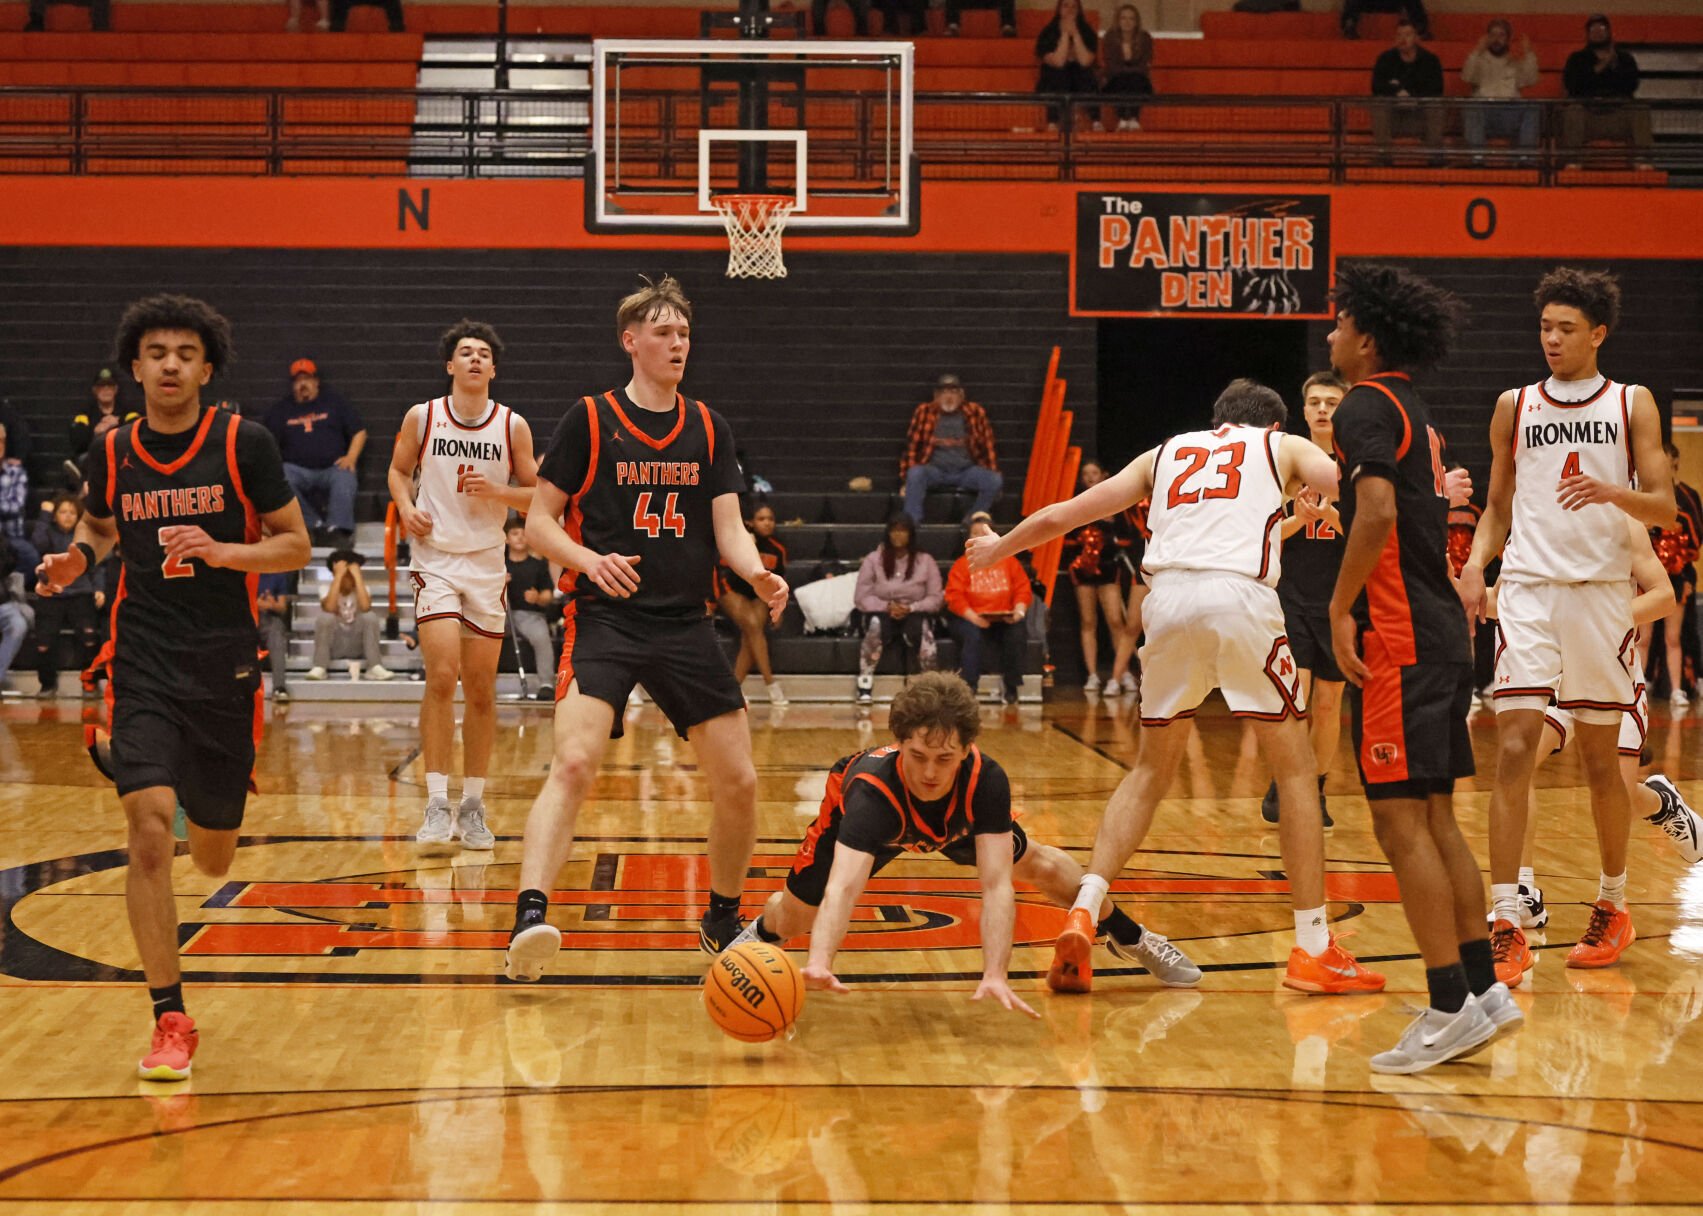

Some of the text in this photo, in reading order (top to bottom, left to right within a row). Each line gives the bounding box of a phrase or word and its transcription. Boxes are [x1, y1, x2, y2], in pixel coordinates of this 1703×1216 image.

[398, 188, 430, 231] N
[1102, 197, 1143, 214] The
[1466, 198, 1497, 240] O
[1100, 215, 1314, 270] PANTHER
[1161, 272, 1232, 307] DEN
[432, 438, 502, 462] IRONMEN
[1525, 421, 1618, 449] IRONMEN
[616, 461, 700, 486] PANTHERS
[1167, 441, 1246, 510] 23
[1561, 451, 1583, 480] 4
[121, 485, 224, 521] PANTHERS
[633, 492, 686, 538] 44
[1279, 656, 1293, 676] N
[720, 955, 766, 1009] Wilson
